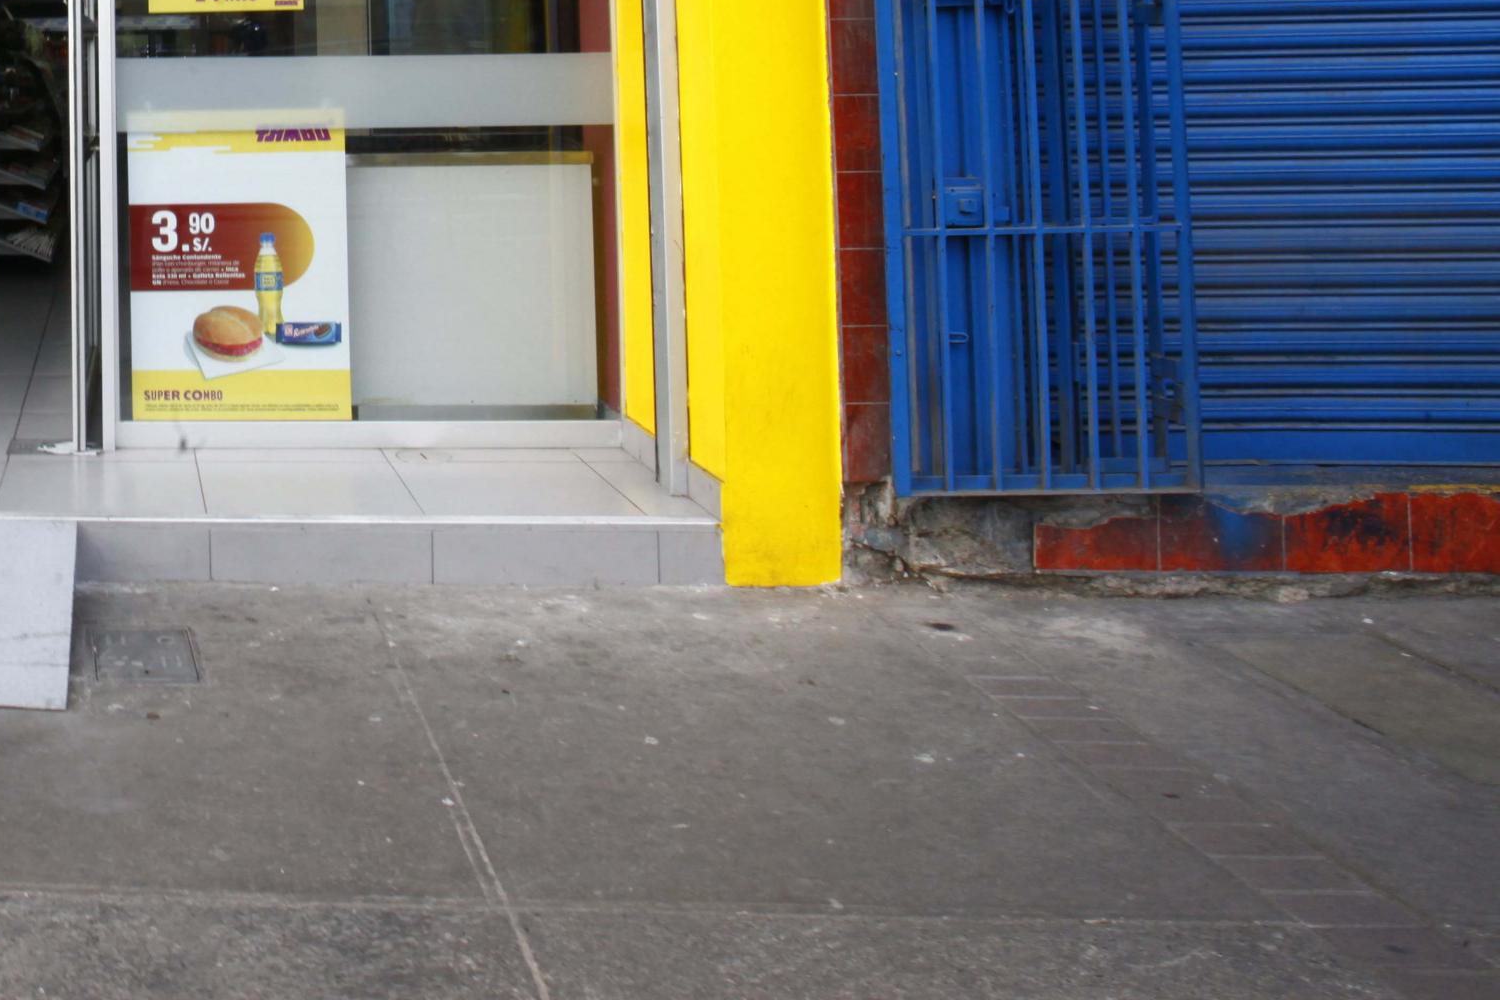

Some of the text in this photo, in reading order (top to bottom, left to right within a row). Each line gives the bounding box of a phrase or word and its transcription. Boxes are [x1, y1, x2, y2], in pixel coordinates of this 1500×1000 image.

[188, 212, 216, 235] 90
[143, 389, 223, 401] SUPER COMBO
